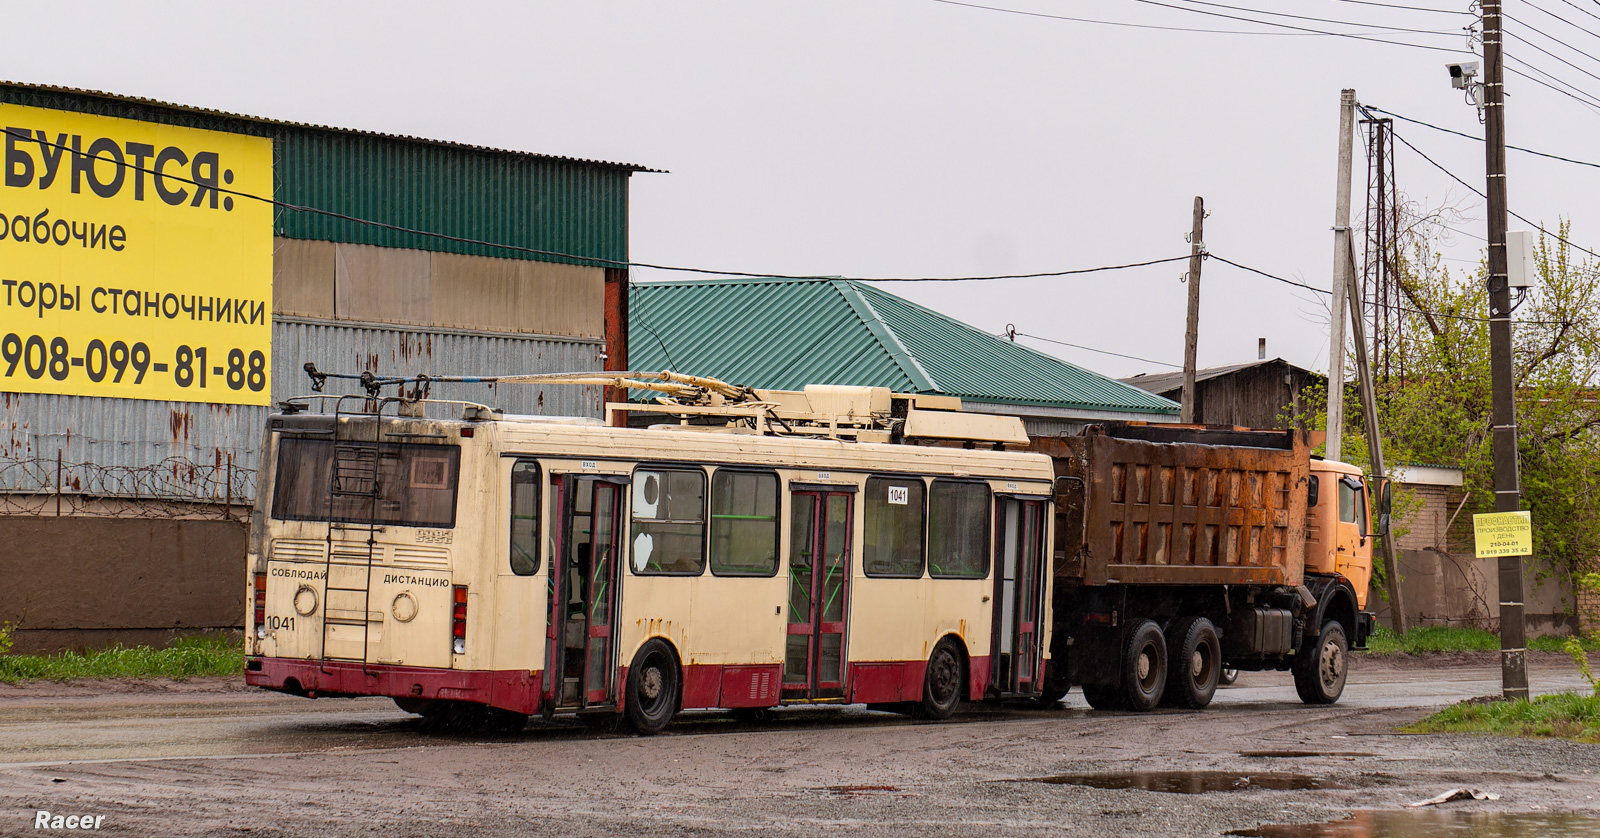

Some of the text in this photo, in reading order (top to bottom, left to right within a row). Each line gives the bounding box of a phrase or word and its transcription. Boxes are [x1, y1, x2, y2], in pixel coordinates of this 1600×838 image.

[4, 126, 235, 212] БУЮТСЯ:
[1, 278, 265, 326] торы станочники
[890, 489, 906, 502] 1041
[271, 568, 450, 588] СОБЛЮДАЙ ДИСТАНЦИЮ
[266, 615, 296, 632] 1041
